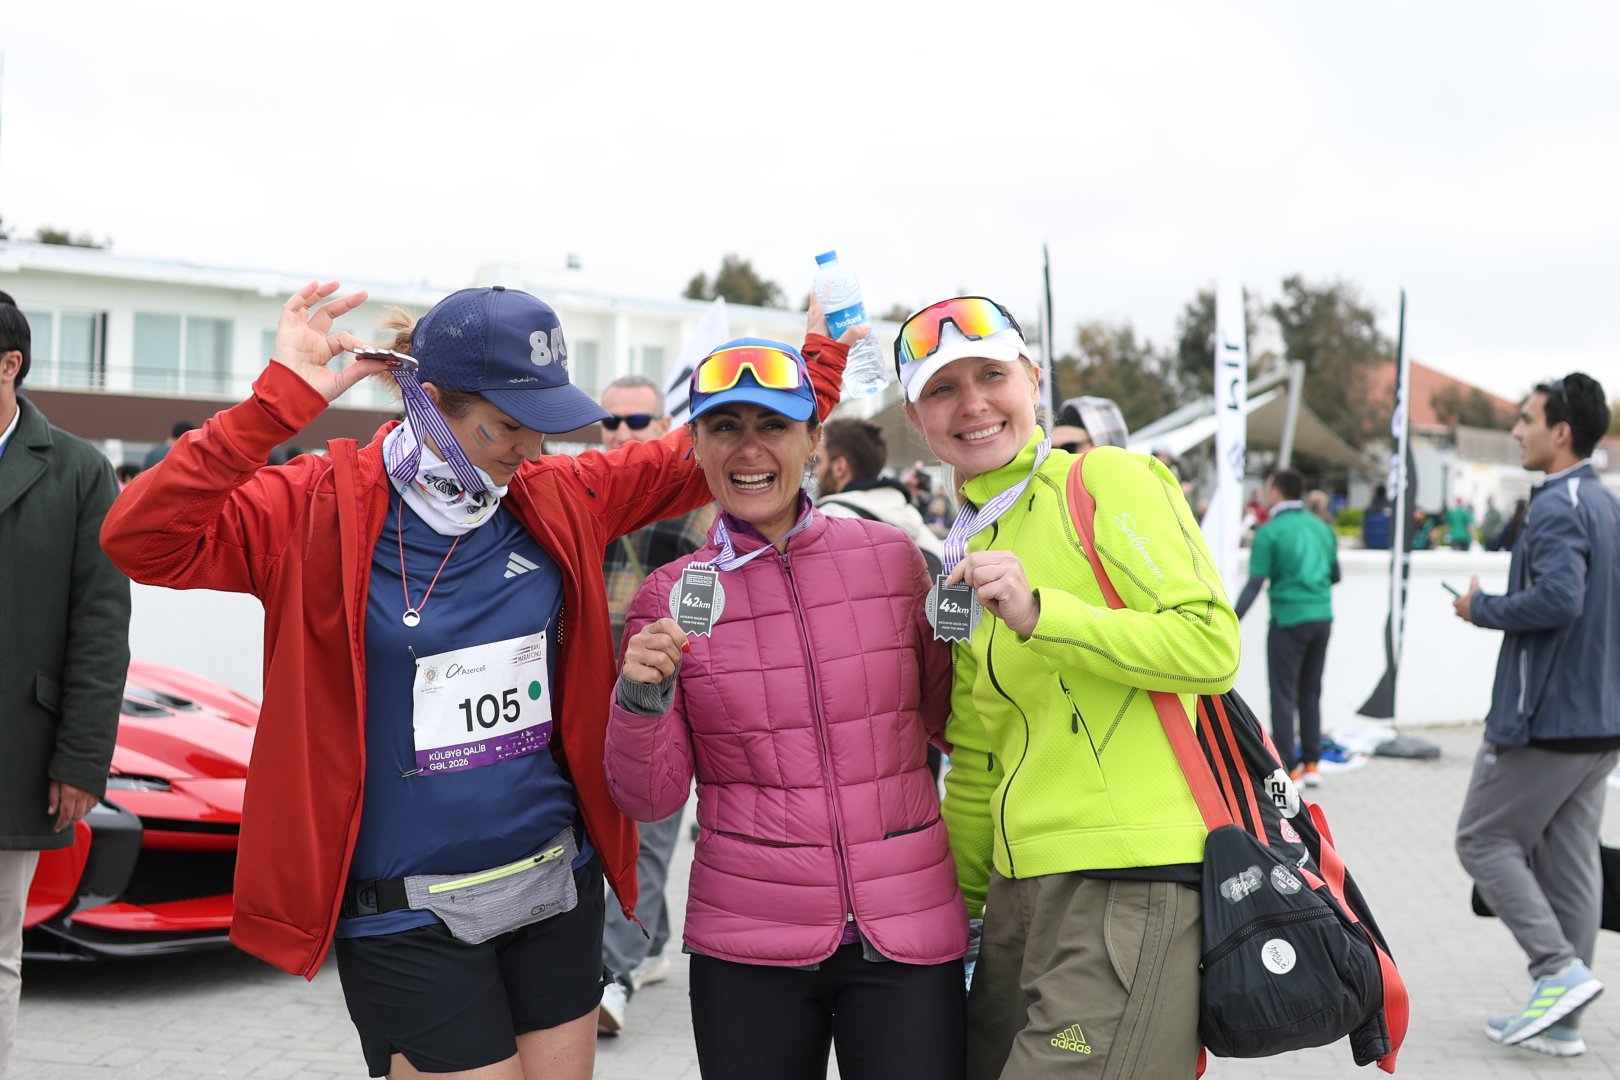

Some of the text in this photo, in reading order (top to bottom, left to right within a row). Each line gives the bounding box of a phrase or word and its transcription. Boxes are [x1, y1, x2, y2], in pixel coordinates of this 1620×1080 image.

[682, 592, 711, 609] 42km
[939, 598, 970, 614] 42km
[461, 664, 486, 676] Azercell
[459, 688, 521, 732] 105
[428, 748, 462, 761] KÜLƏYƏ
[463, 744, 486, 756] QALİB
[429, 759, 469, 771] GƏL 2026
[1051, 1038, 1091, 1054] adidas
